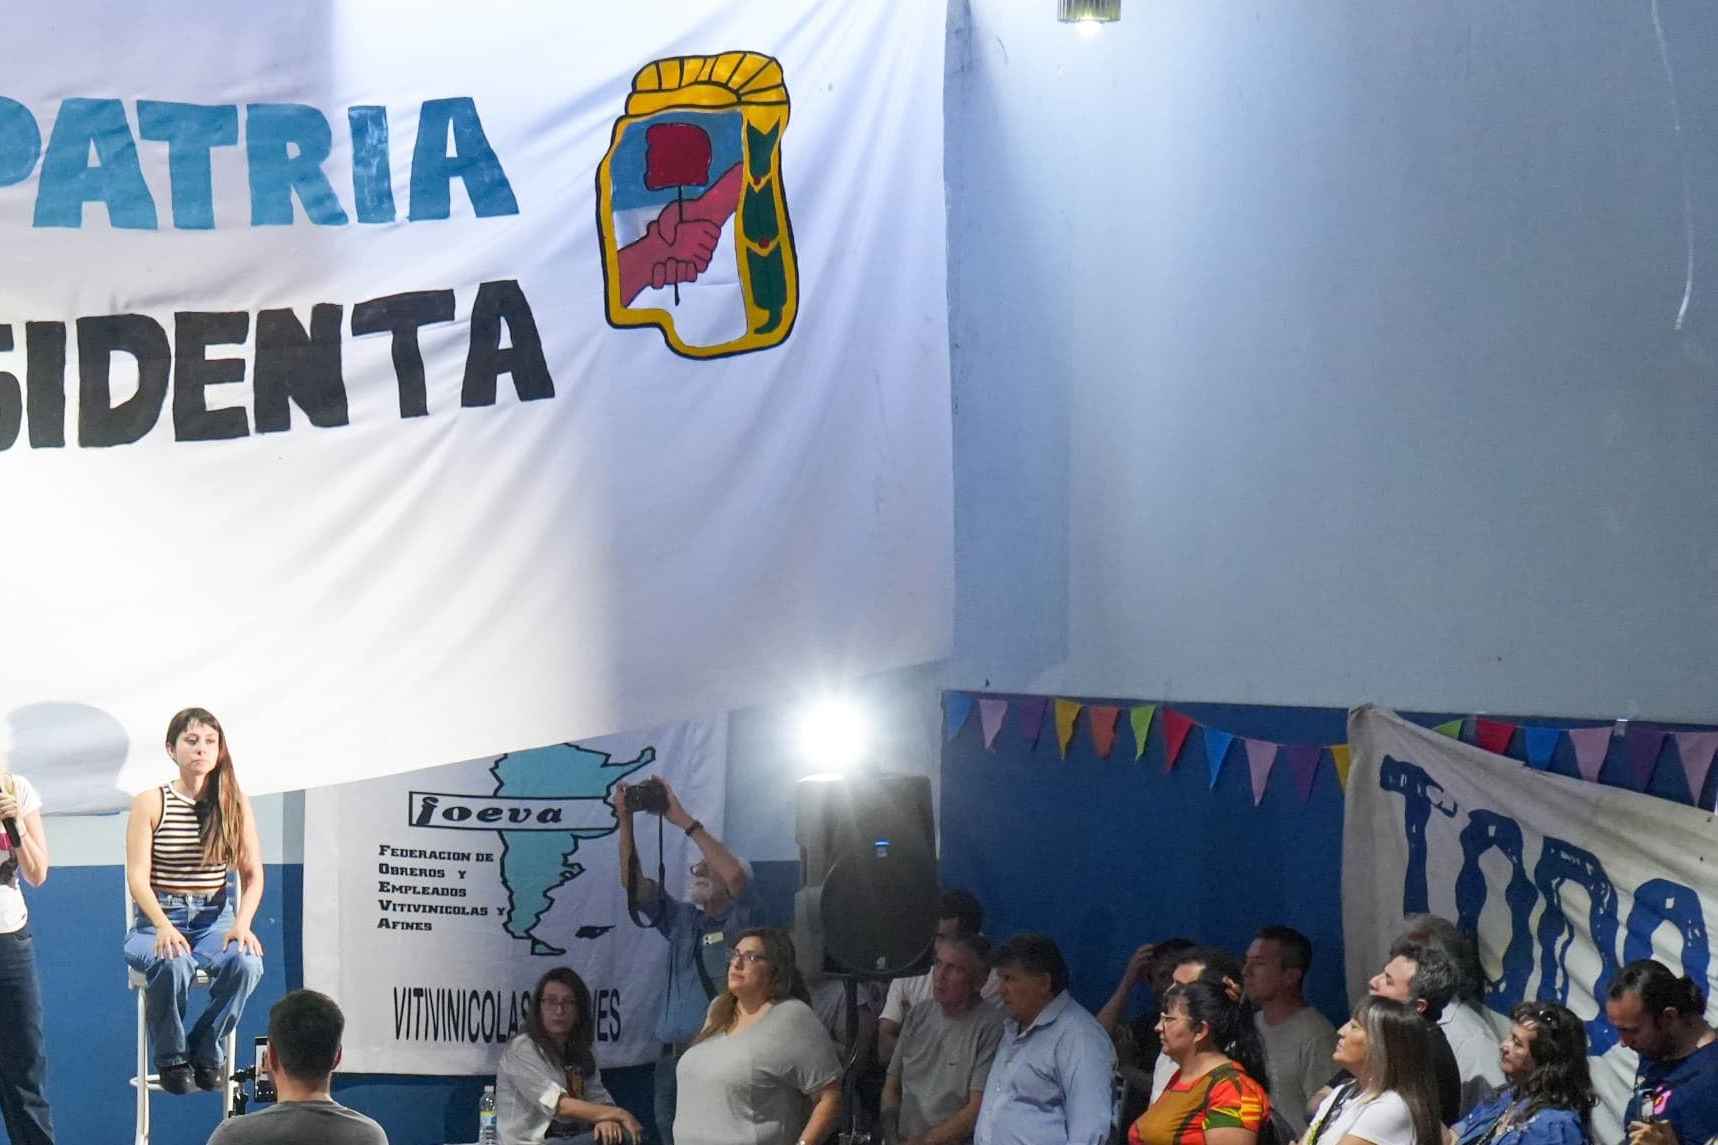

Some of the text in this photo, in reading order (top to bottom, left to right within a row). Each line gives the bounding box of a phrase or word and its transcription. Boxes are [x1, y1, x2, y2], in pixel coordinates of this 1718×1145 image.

[378, 844, 495, 863] FEDERACION DE
[378, 863, 446, 878] OBREROS
[378, 881, 467, 898] EMPLEADOS
[378, 899, 489, 916] VITIVINICOLAS
[377, 918, 433, 932] AFINES
[393, 986, 532, 1044] VITIVINICOLAS
